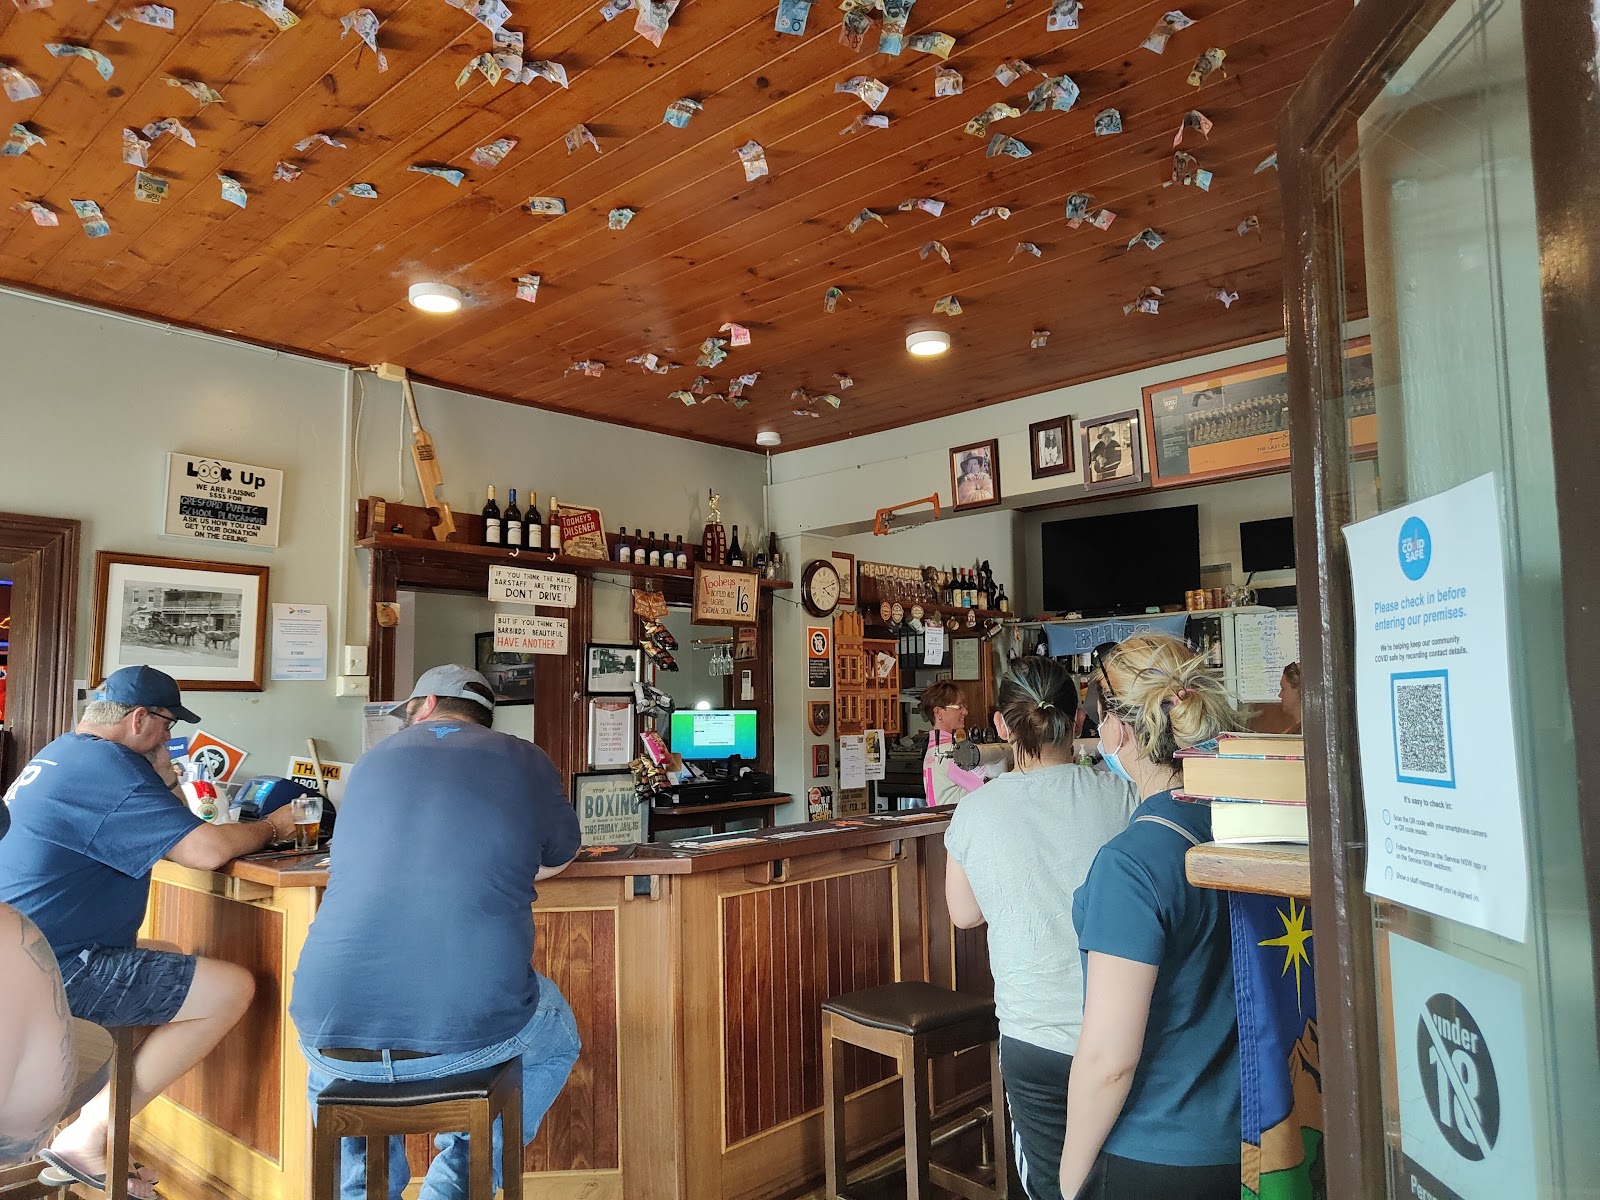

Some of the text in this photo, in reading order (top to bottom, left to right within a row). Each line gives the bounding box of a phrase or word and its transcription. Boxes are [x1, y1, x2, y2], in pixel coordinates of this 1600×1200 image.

[196, 483, 256, 498] WE ARE RAISING
[228, 494, 243, 502] FOR
[181, 496, 259, 515] GRESFORD PUBLIC
[181, 506, 266, 525] SCHOOL PLAYGROUND
[562, 513, 592, 527] TOOHEYS
[200, 517, 210, 525] US
[211, 519, 228, 527] HOW
[230, 521, 245, 529] YOU
[246, 523, 261, 531] CAN
[563, 521, 596, 539] PILSENER
[207, 532, 220, 540] THE
[222, 534, 248, 543] CEILING
[223, 527, 259, 537] DONATION
[1405, 549, 1424, 562] SAFE
[507, 571, 520, 579] YOU
[556, 576, 571, 584] MALE
[899, 568, 923, 582] GENER
[494, 578, 527, 588] BARSTAFF
[701, 575, 736, 595] Tooheys
[1375, 586, 1466, 615] Please check in before
[1375, 606, 1467, 630] entering our premises.
[497, 627, 564, 638] BARBIRDS BEAUTIFUL
[497, 637, 519, 648] HAVE
[522, 638, 556, 649] ANOTHER
[1380, 635, 1460, 652] We're helping keep our community
[1375, 646, 1468, 663] COVID safe by recording contact details.
[169, 743, 184, 751] hand
[296, 763, 339, 777] THNK!
[585, 793, 639, 818] BOXING
[1403, 795, 1411, 804] It's
[1412, 798, 1423, 807] easy
[1423, 799, 1429, 807] to
[1429, 800, 1445, 809] check
[584, 825, 598, 835] THIS
[1393, 814, 1402, 822] Scan
[1409, 816, 1416, 824] QR
[1416, 818, 1426, 827] code
[1426, 820, 1434, 828] with
[1435, 822, 1445, 830] your
[1445, 824, 1470, 835] smartphone
[1470, 829, 1488, 838] camera
[1398, 824, 1405, 832] QR
[1405, 826, 1415, 834] code
[1396, 842, 1408, 852] Follow
[1414, 848, 1430, 858] prompts
[1444, 854, 1460, 865] Service
[1460, 857, 1472, 867] NSW
[1473, 861, 1482, 871] app
[1482, 863, 1487, 871] or
[1408, 855, 1422, 865] Service
[1422, 859, 1433, 868] NSW
[1433, 862, 1453, 873] webform.
[1396, 872, 1406, 880] Show
[1419, 879, 1435, 889] member
[1435, 883, 1443, 891] that
[1443, 886, 1457, 896] you've
[1457, 889, 1472, 900] signed
[1433, 1013, 1479, 1054] under
[1429, 1045, 1482, 1145] 18
